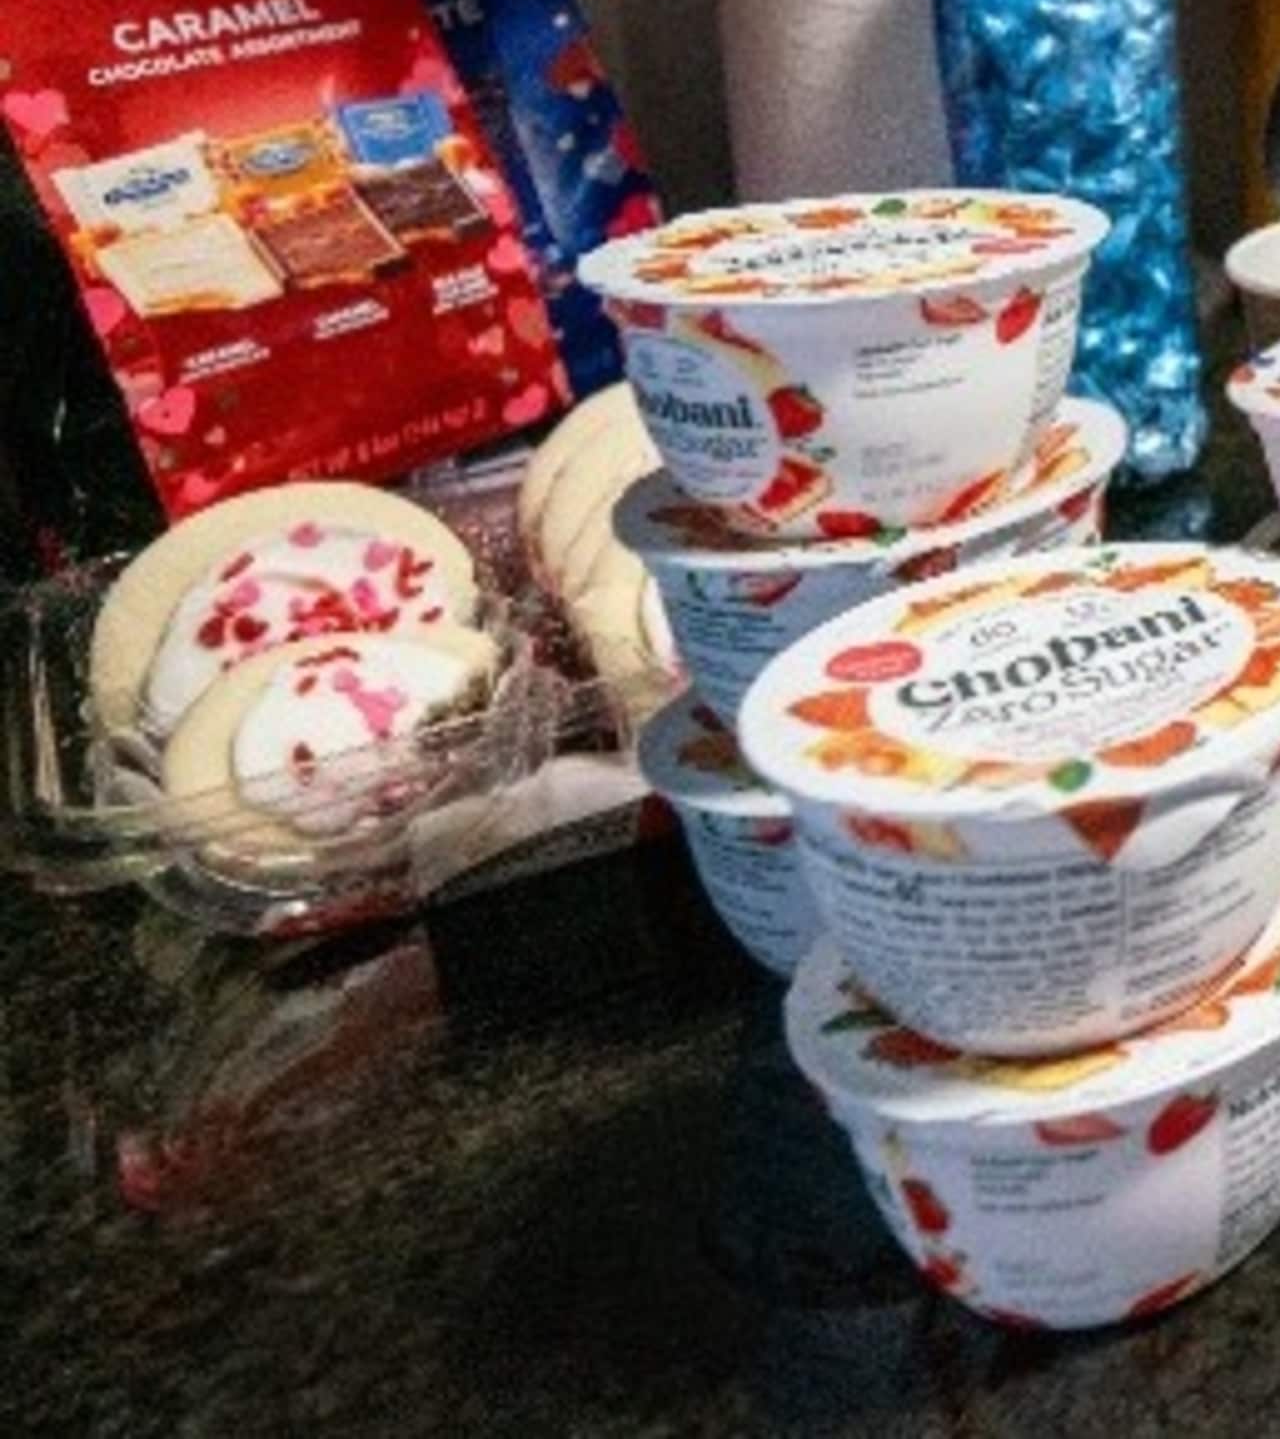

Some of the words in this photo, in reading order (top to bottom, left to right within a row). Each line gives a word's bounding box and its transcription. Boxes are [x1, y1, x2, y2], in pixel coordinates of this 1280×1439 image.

[89, 45, 224, 87] CHOCOLATE
[229, 19, 362, 61] ASSORTMENT
[899, 595, 1208, 711] Chobani
[1061, 631, 1222, 700] Sugar
